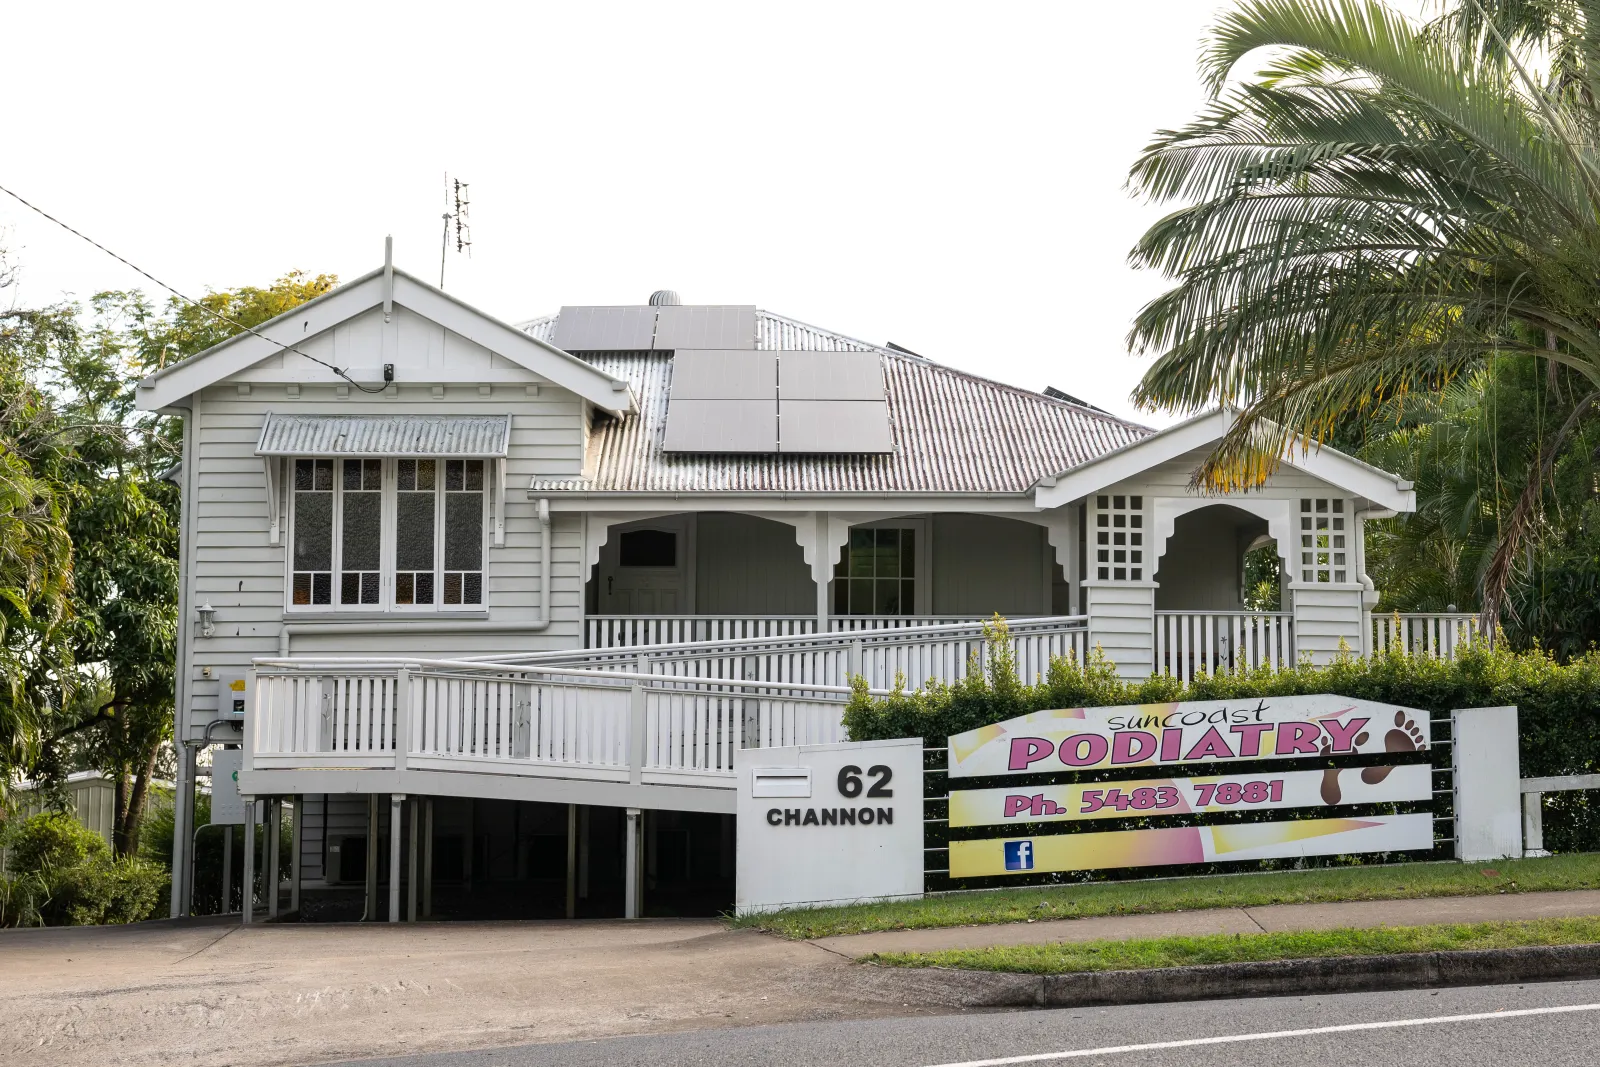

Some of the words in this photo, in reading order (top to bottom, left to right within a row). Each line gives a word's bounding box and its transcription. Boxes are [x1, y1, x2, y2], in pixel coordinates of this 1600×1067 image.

[1107, 699, 1270, 731] suncoast
[1007, 717, 1371, 771] PODIATRY
[837, 764, 893, 798] 62
[1004, 793, 1067, 817] Ph.
[1080, 786, 1179, 814] 5483
[1193, 780, 1284, 807] 7881
[766, 807, 893, 826] CHANNON
